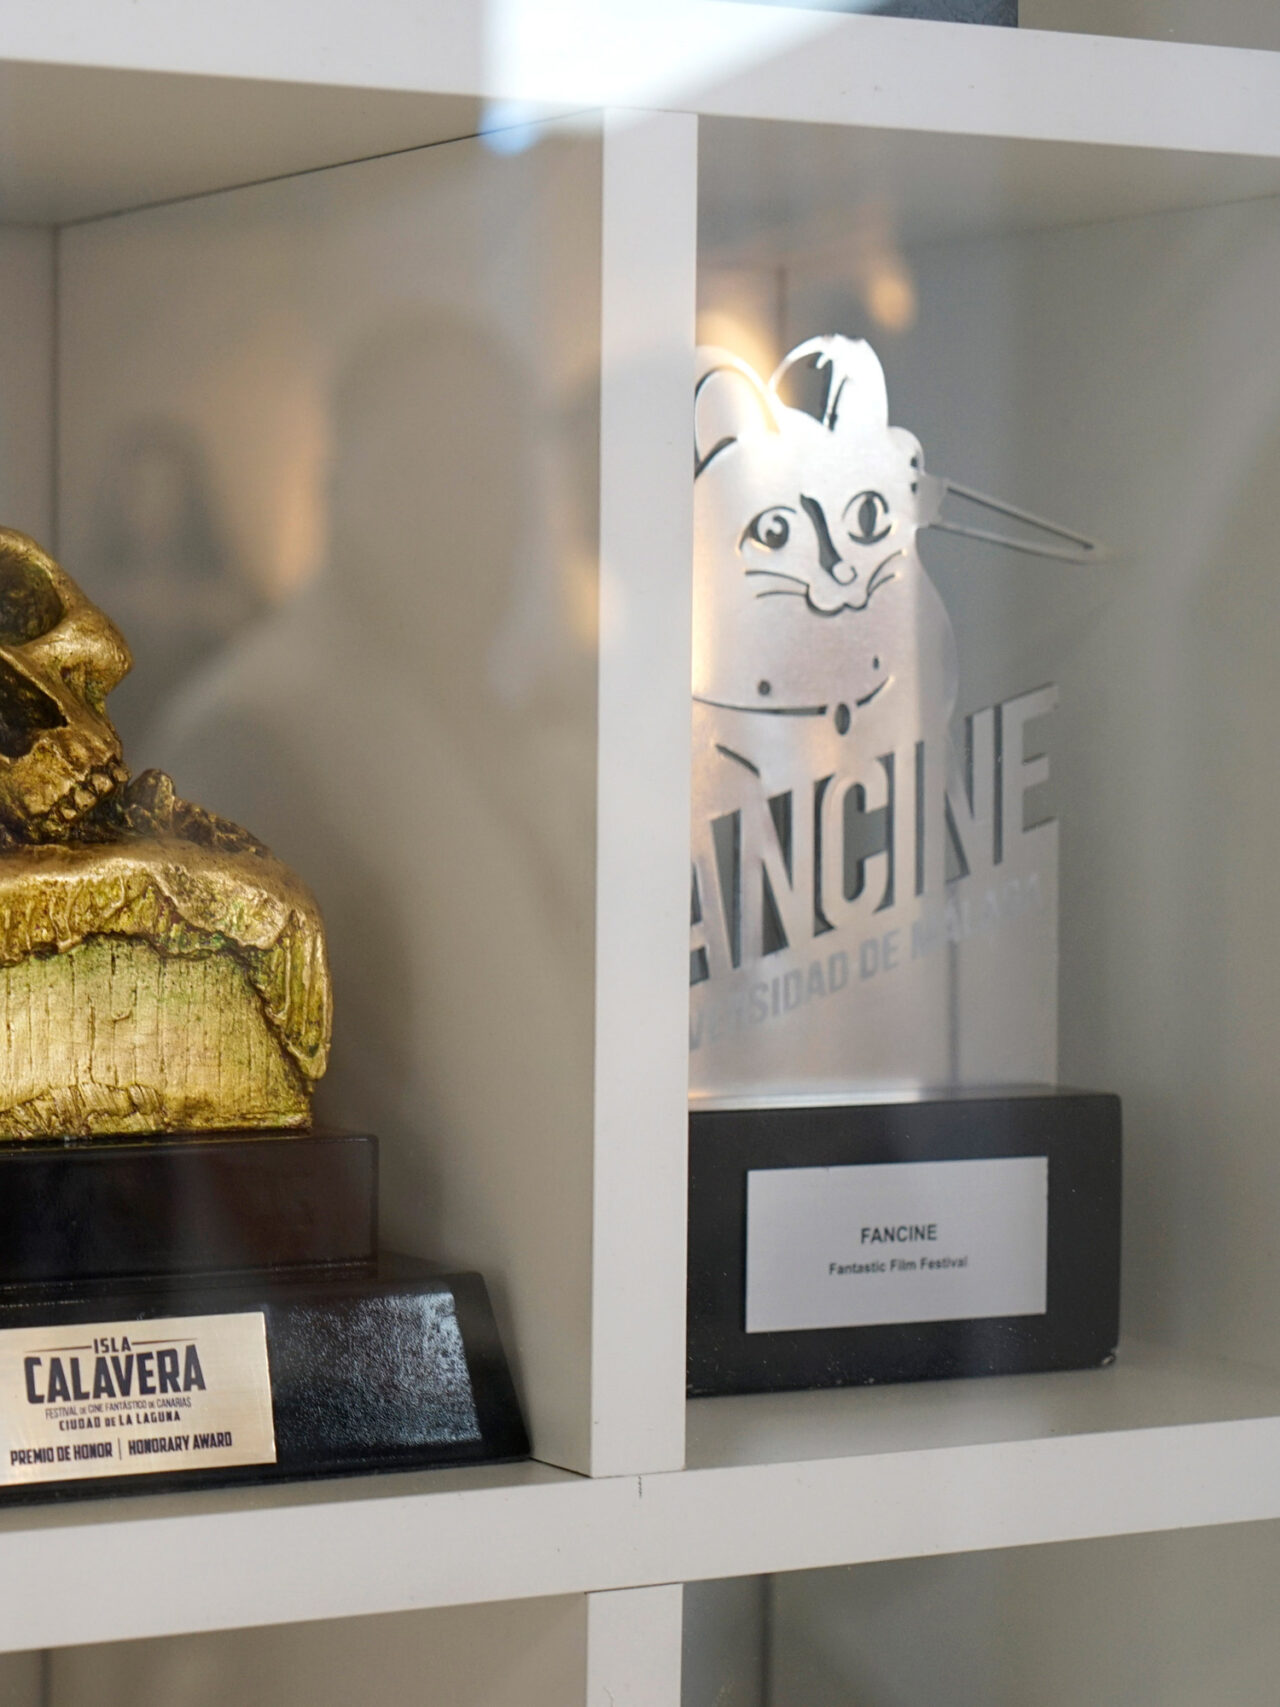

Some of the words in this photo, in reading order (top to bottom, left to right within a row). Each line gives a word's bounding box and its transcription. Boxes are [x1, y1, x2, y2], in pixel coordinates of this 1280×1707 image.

[690, 682, 1059, 988] ANCINE
[858, 929, 901, 982] DE
[860, 1224, 938, 1244] FANCINE
[828, 1261, 887, 1276] Fantastic
[889, 1258, 917, 1272] Film
[920, 1255, 969, 1270] Festival
[94, 1336, 132, 1354] ISLA
[24, 1343, 206, 1404] CALAVERA
[45, 1406, 79, 1419] FESTIVAL
[88, 1403, 104, 1414] CINE
[105, 1399, 147, 1412] FANTÁSTICO
[156, 1396, 192, 1408] CANARIAS
[59, 1416, 101, 1431] CIUDAD
[104, 1417, 116, 1427] DE
[119, 1413, 133, 1426] LA
[137, 1410, 181, 1425] LAGUNA
[10, 1447, 55, 1466] PREMIO
[57, 1446, 71, 1462] DE
[73, 1442, 113, 1461] HONOR
[128, 1435, 190, 1456] HONORARY
[192, 1431, 233, 1448] AWARD
